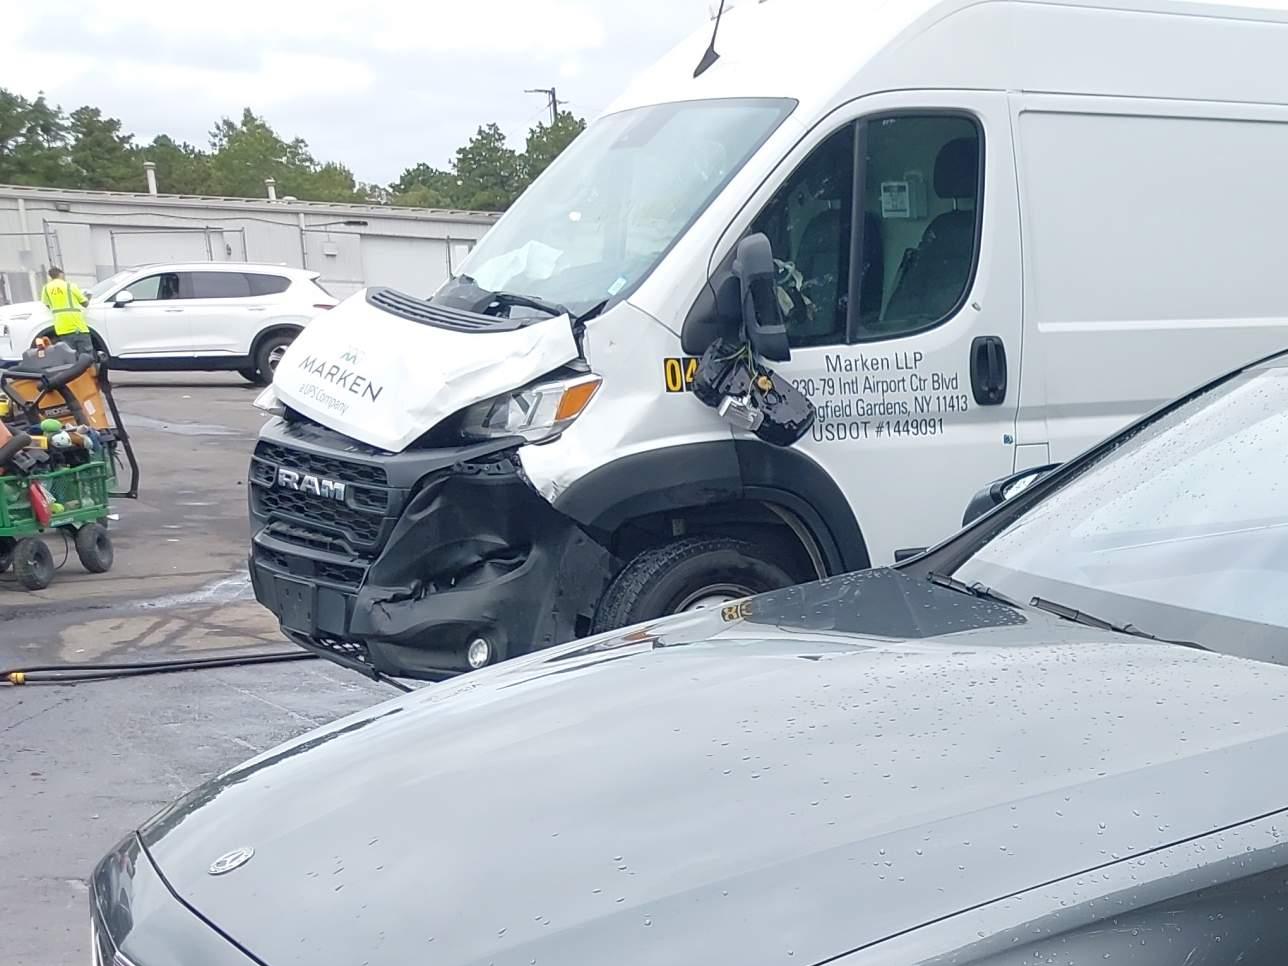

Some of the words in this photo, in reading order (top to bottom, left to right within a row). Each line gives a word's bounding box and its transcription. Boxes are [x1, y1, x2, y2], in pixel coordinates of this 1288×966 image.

[825, 354, 890, 373] Marken
[895, 352, 923, 370] LLP
[298, 354, 384, 403] MARKEN
[791, 378, 835, 397] 230-79
[839, 375, 859, 395] Intl
[863, 375, 906, 399] Airport
[910, 373, 928, 393] Ctr
[932, 372, 959, 391] Blvd
[303, 384, 316, 399] UPS
[315, 389, 350, 416] Company
[855, 398, 911, 419] Gardens,
[914, 396, 932, 414] NY
[935, 394, 969, 413] 11413
[812, 421, 872, 442] USDOT
[875, 417, 944, 438] #1449091
[278, 468, 346, 501] RAM
